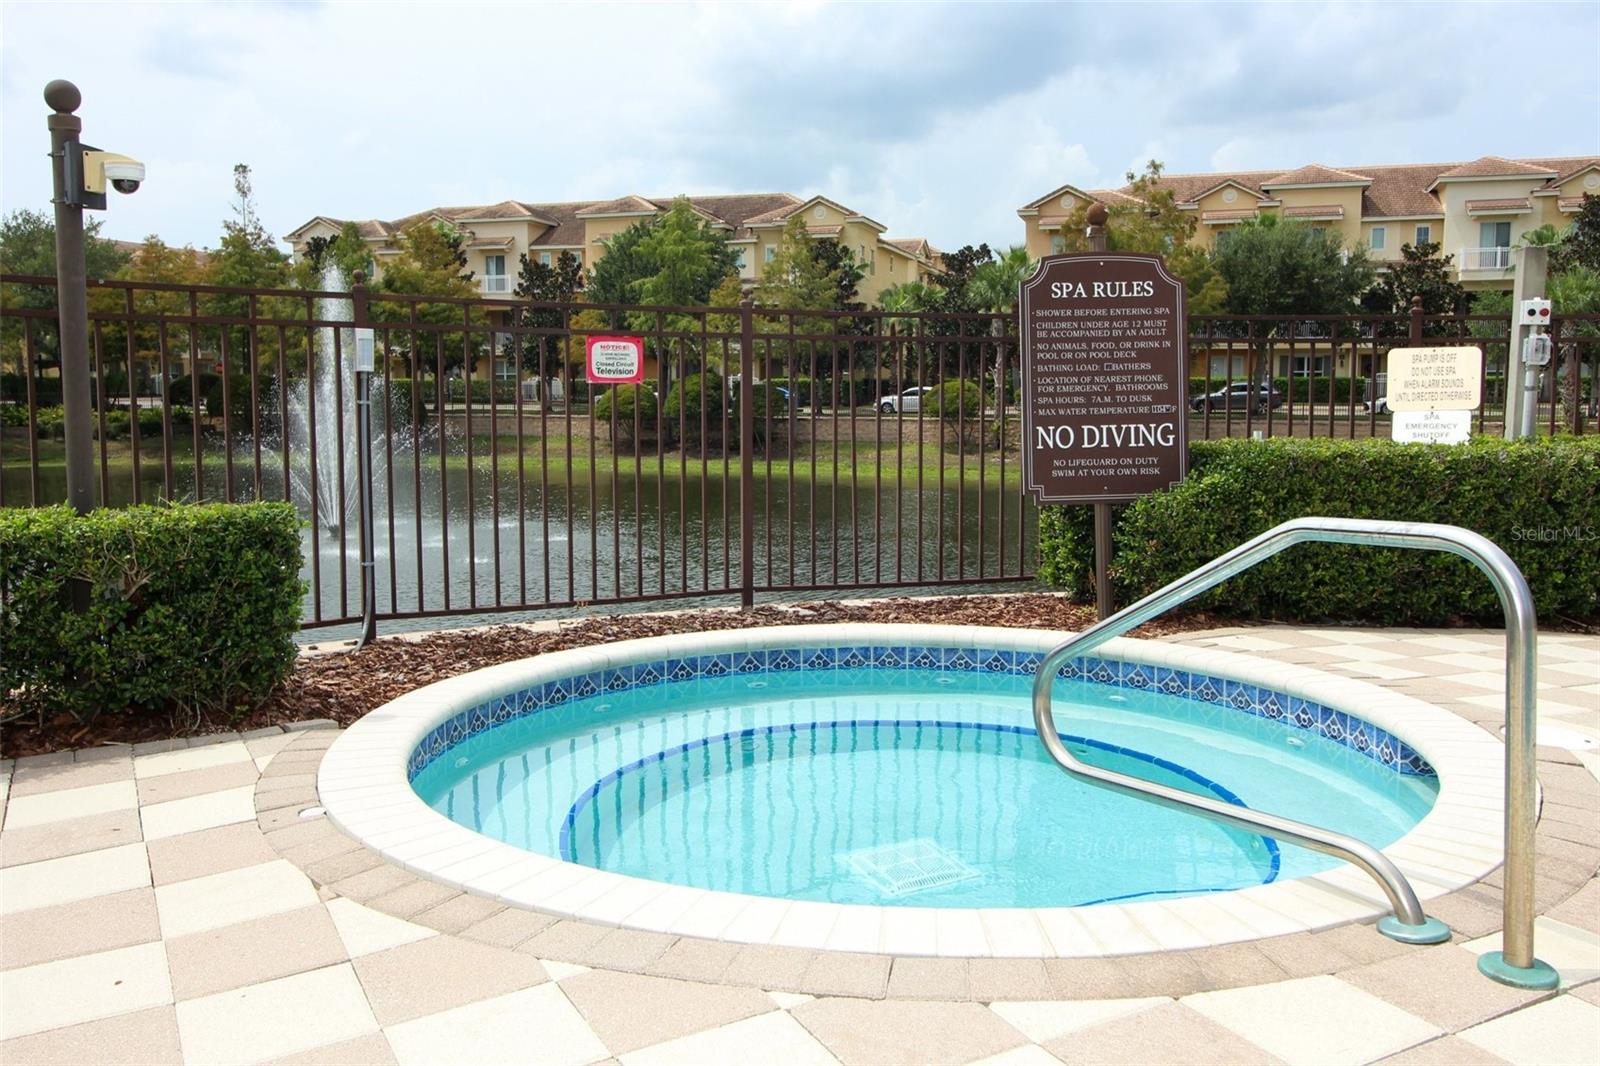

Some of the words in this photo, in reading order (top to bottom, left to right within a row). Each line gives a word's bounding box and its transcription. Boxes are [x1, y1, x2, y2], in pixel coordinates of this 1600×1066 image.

[1051, 282, 1088, 298] SPA
[1092, 280, 1154, 298] RULES
[1036, 309, 1072, 317] SHOWER
[1074, 308, 1108, 316] BEFORE
[1110, 308, 1152, 316] ENTERING
[1036, 322, 1078, 330] CHILDREN
[1144, 320, 1168, 328] MUST
[1037, 330, 1048, 338] BE
[1050, 329, 1110, 338] ACCOMPANIED
[1125, 328, 1137, 336] AN
[1138, 328, 1167, 336] ADULT
[1037, 342, 1049, 350] NO
[1120, 341, 1132, 349] OR
[1134, 340, 1160, 348] DRINK
[1412, 354, 1422, 364] SPA
[1424, 354, 1438, 364] PUMP
[1440, 354, 1445, 363] IS
[1446, 353, 1457, 362] OFF
[596, 367, 635, 375] Television
[1038, 364, 1074, 372] BATHING
[1076, 364, 1100, 372] LOAD:
[1112, 362, 1152, 371] BATHERS
[1412, 366, 1419, 376] DO
[1421, 366, 1432, 376] NOT
[1434, 366, 1444, 376] USE
[1446, 366, 1456, 376] SPA
[1038, 376, 1078, 384] LOCATION
[1404, 380, 1420, 389] WHEN
[1421, 379, 1440, 388] ALARM
[1441, 378, 1464, 388] SOUNDS
[1115, 384, 1168, 392] BATHROOMS
[1038, 396, 1053, 404] SPA
[1056, 396, 1086, 404] HOURS:
[1395, 392, 1410, 402] UNTIL
[1412, 392, 1438, 402] DIRECTED
[1440, 390, 1472, 400] OTHERWISE
[1038, 408, 1056, 416] MAX
[1058, 408, 1087, 416] WATER
[1089, 406, 1150, 415] TEMPERATURE
[1036, 425, 1074, 450] NO
[1081, 422, 1176, 448] DIVING
[1068, 458, 1118, 466] LIFEGUARD
